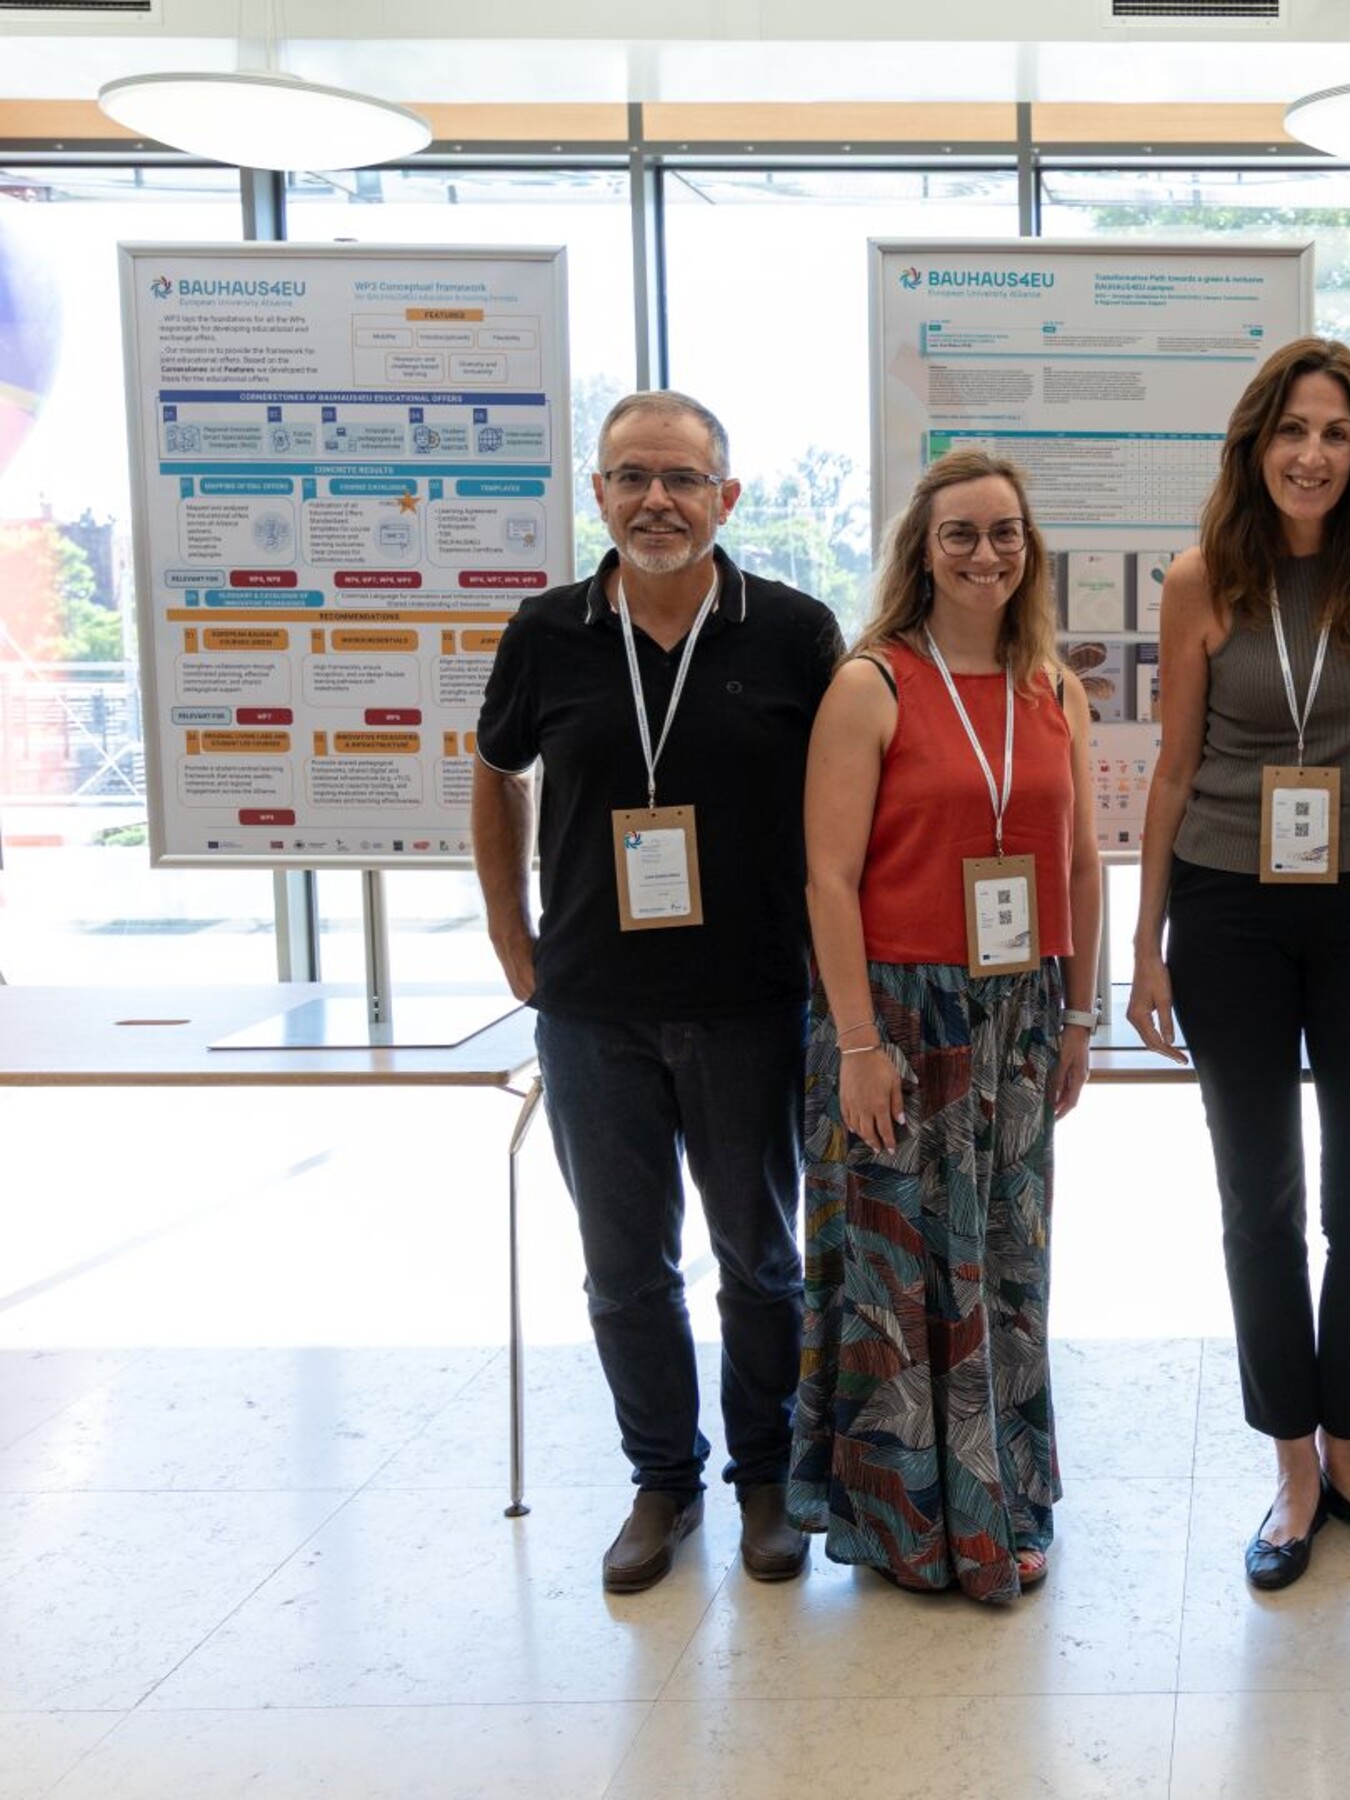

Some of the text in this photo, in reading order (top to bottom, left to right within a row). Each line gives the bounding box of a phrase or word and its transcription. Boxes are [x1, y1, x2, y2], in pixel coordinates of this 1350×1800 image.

[928, 271, 1054, 288] BAUHAUS4EU
[1094, 274, 1148, 283] Transformative
[1150, 274, 1166, 283] Path
[1168, 274, 1196, 283] towards
[1204, 276, 1223, 285] green
[178, 280, 306, 296] BAUHAUS4EU
[354, 282, 486, 294] WP3 Conceptual framework
[928, 290, 1041, 298] European University Alliance
[180, 298, 292, 307] European University Alliance
[424, 311, 466, 320] FEATURES
[240, 393, 304, 402] CORNERSTONES
[306, 393, 317, 402] OF
[374, 394, 430, 402] EDUCATIONAL
[432, 394, 462, 403] OFFERS
[314, 466, 394, 474] CONCRETE RESULTS
[480, 484, 520, 492] TEMPLATES
[320, 612, 400, 621] RECOMMENDATIONS
